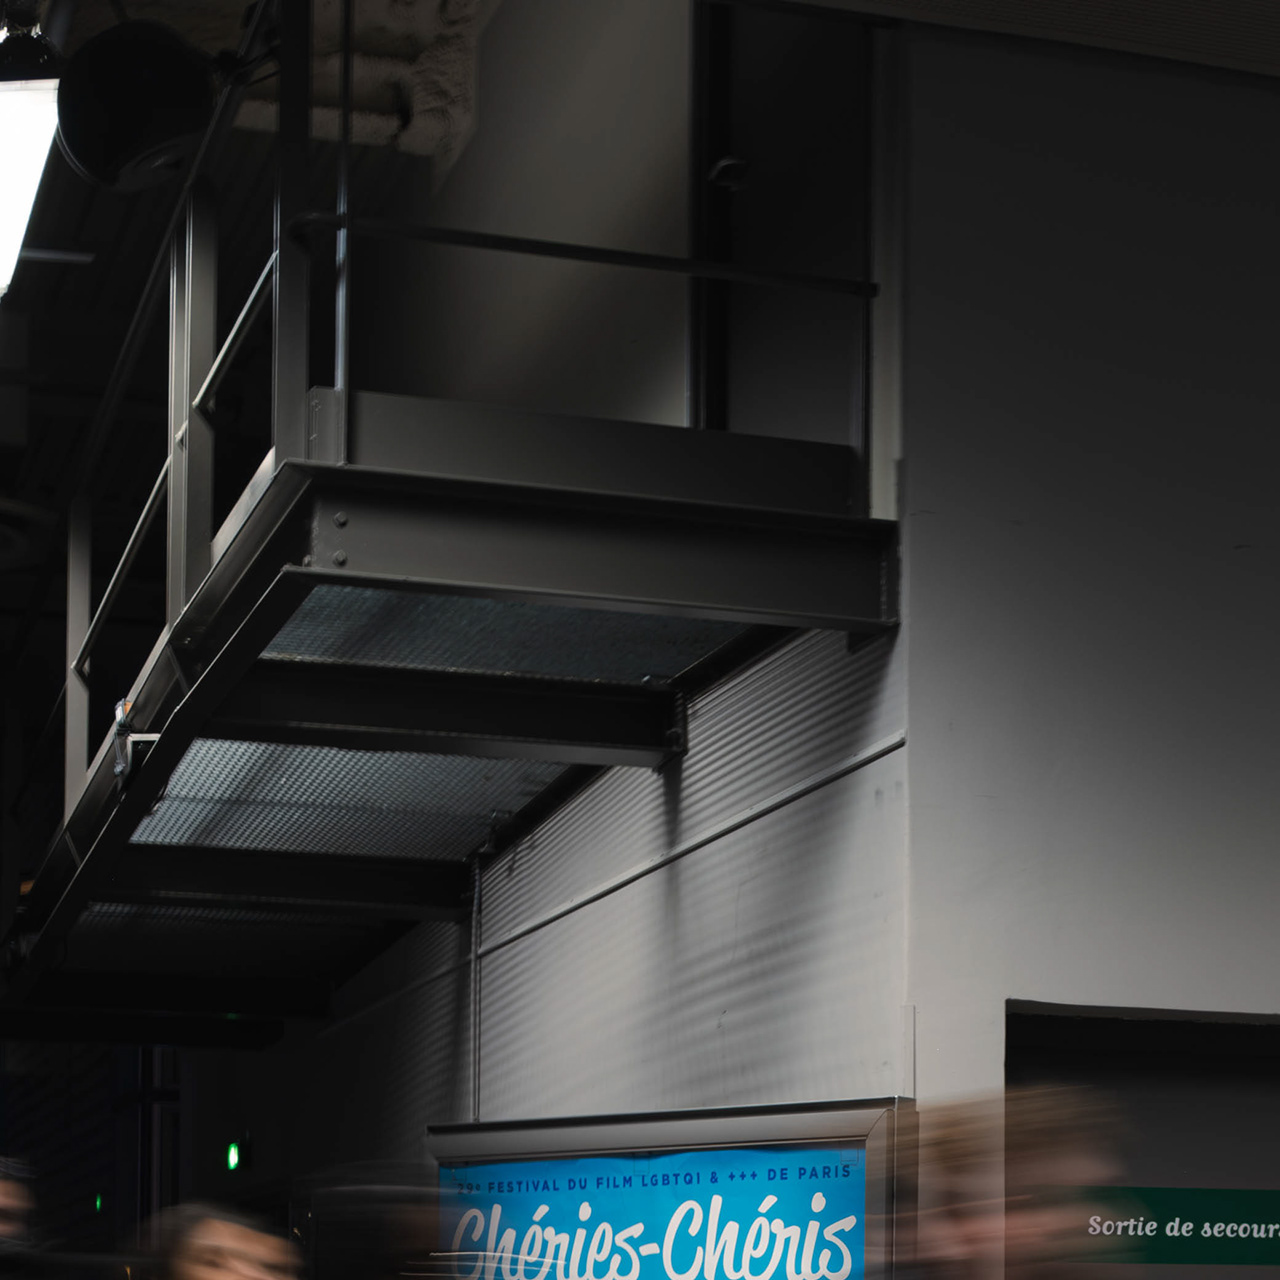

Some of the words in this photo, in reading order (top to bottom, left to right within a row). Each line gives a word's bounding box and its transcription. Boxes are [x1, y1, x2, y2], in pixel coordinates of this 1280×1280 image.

[487, 1179, 560, 1194] FESTIVAL
[568, 1177, 588, 1191] DU
[596, 1175, 633, 1190] FILM
[641, 1172, 700, 1187] LGBTQI
[710, 1171, 719, 1184] &
[728, 1171, 758, 1182] +++
[767, 1168, 789, 1181] DE
[798, 1164, 851, 1180] PARIS
[1087, 1215, 1158, 1237] Sortie
[1165, 1217, 1194, 1238] de
